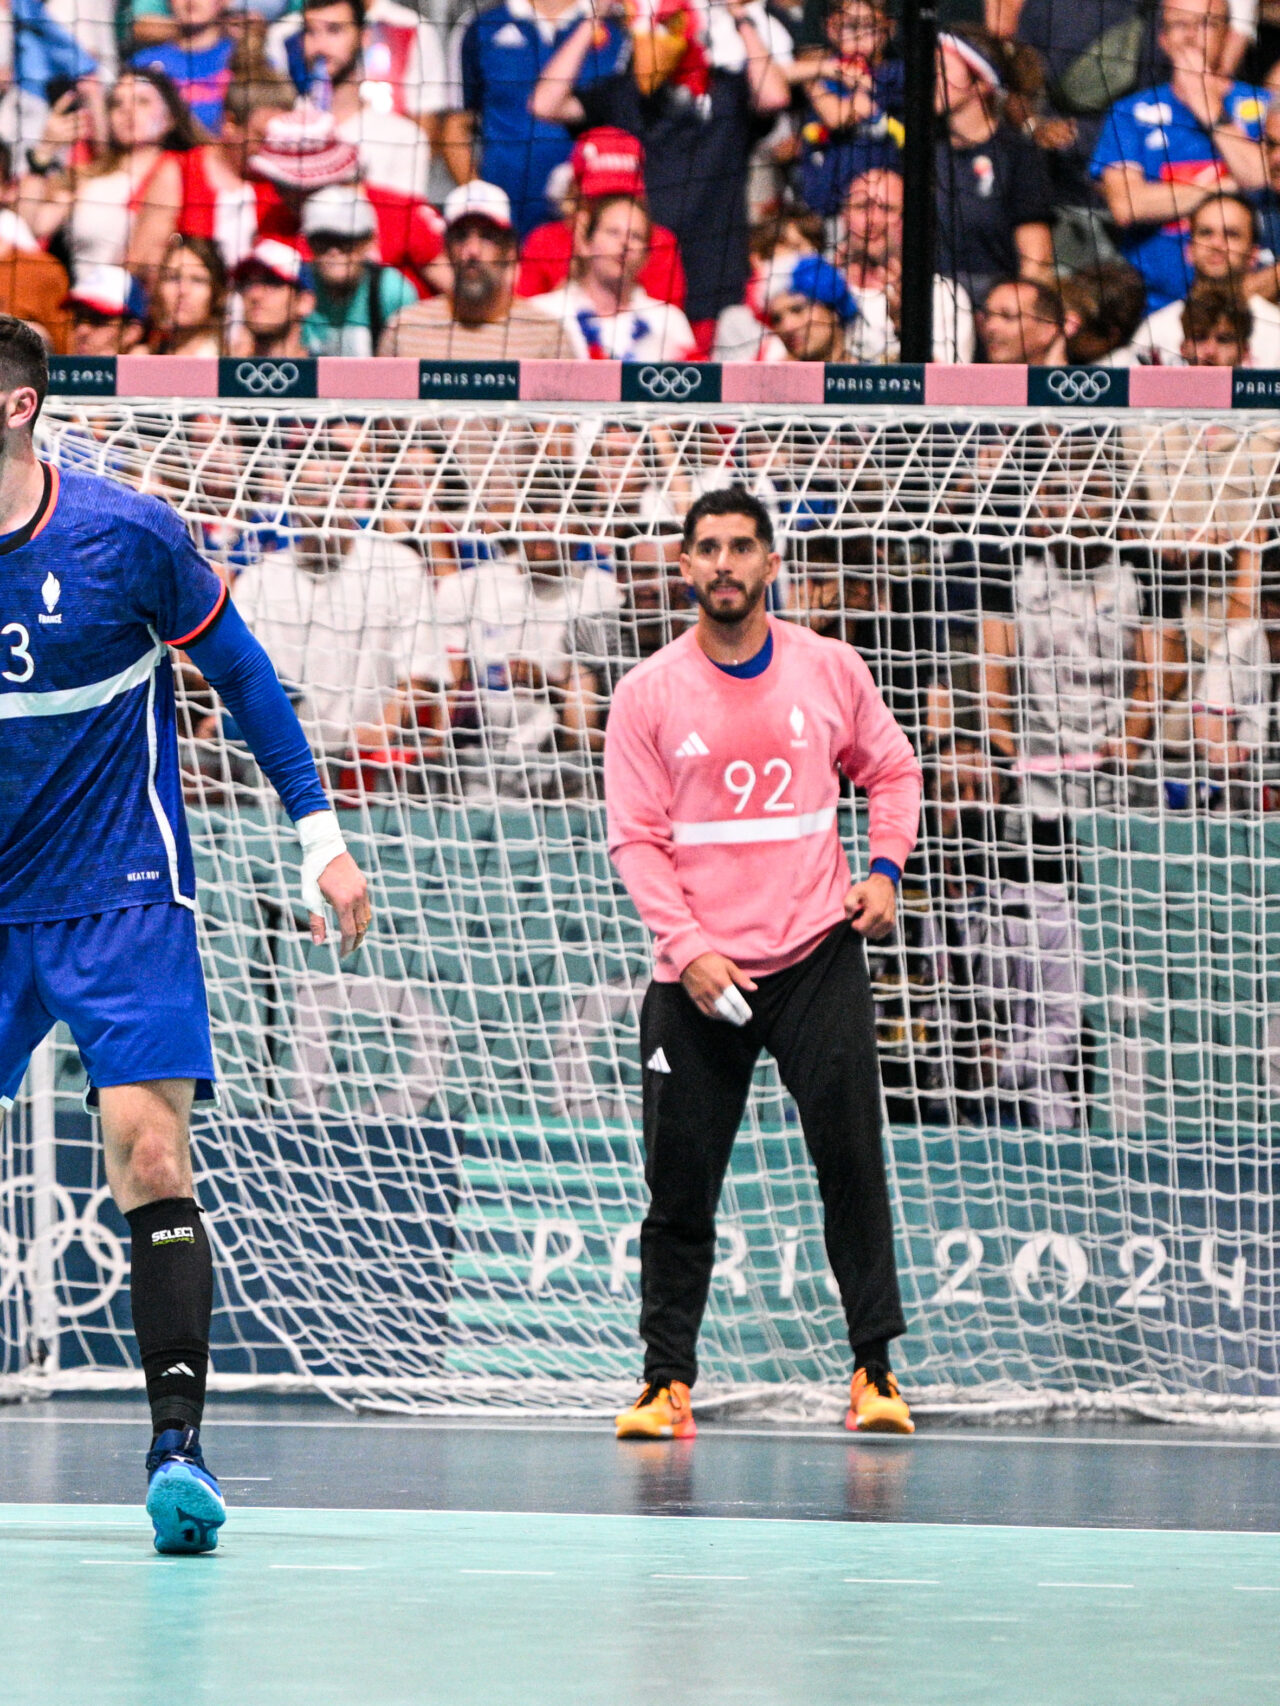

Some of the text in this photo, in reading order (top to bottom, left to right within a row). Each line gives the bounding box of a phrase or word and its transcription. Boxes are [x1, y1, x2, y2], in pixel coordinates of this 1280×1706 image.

[473, 373, 516, 386] 2024
[879, 379, 921, 391] 2024
[724, 758, 795, 814] 92
[151, 1226, 195, 1243] SELECT
[928, 1228, 1248, 1310] 2024
